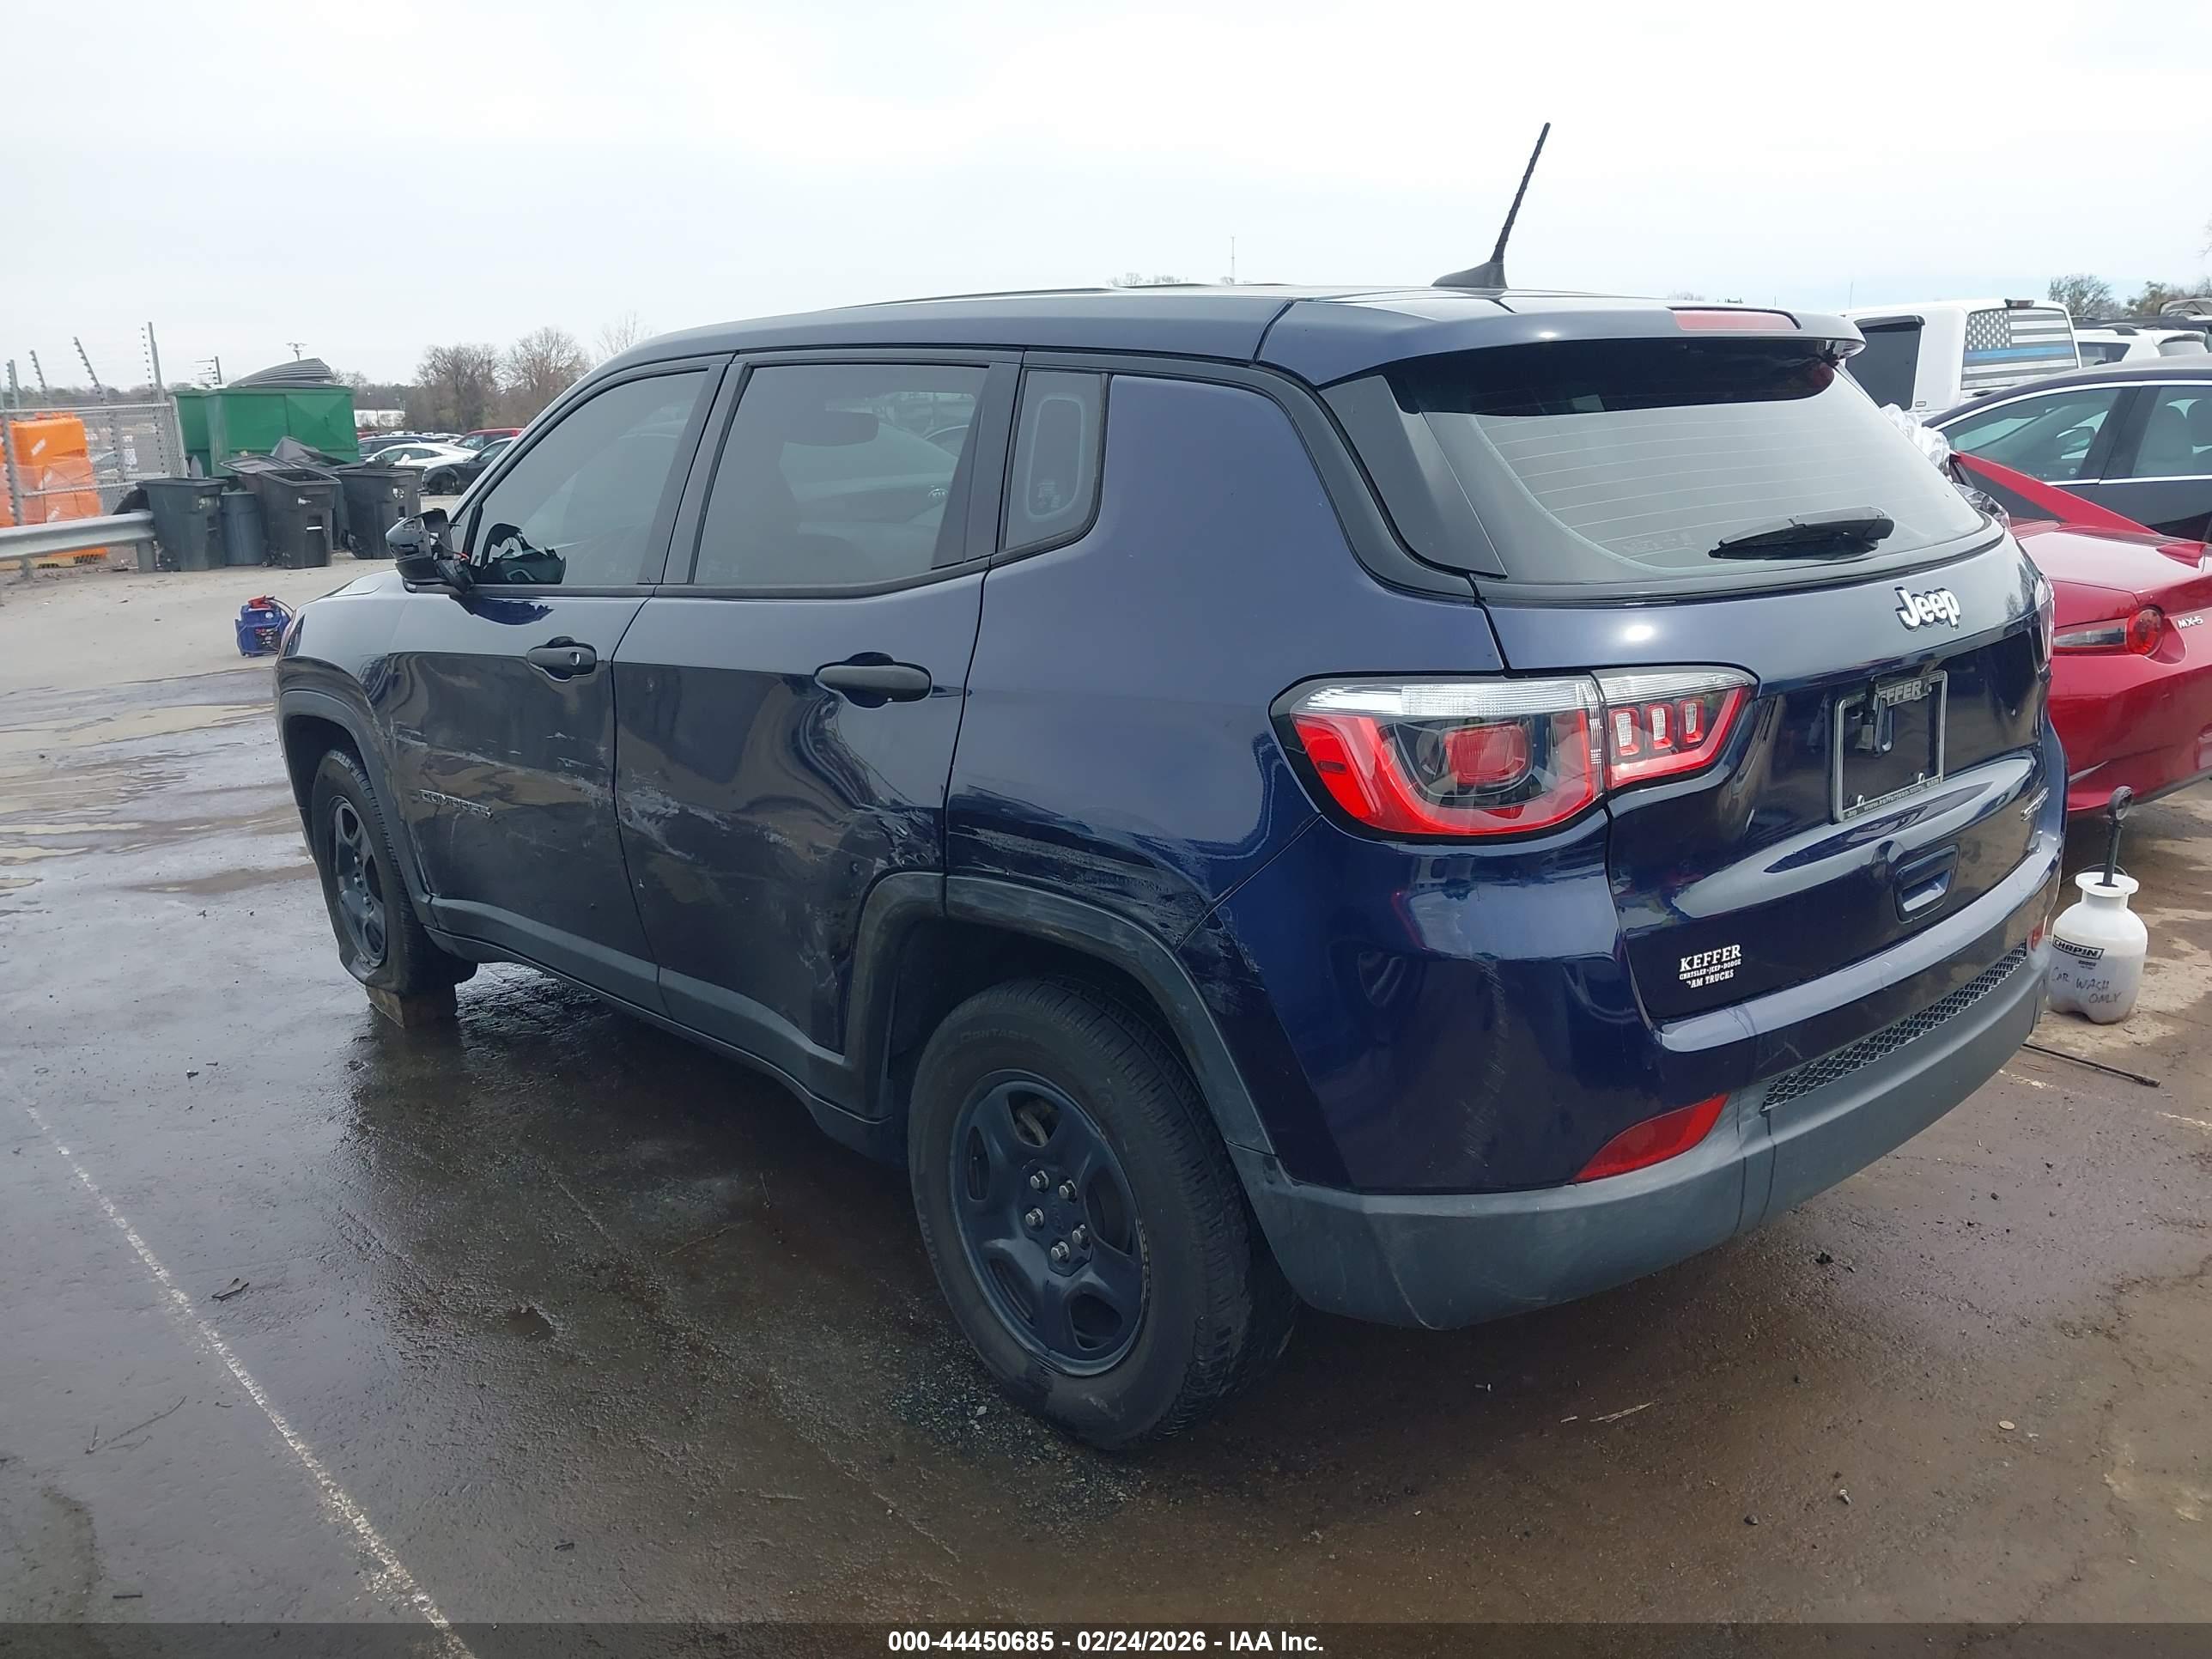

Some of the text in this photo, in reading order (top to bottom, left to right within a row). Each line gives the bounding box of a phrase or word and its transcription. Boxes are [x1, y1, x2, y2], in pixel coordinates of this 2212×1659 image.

[1896, 588, 1960, 629] Jeep
[2177, 616, 2203, 629] MX-5
[2054, 939, 2099, 957] CHAPIN
[1680, 945, 1742, 972] KEFFER
[1705, 969, 1735, 985] TRUCKS
[2075, 977, 2110, 991] WASH
[2088, 992, 2122, 1004] ONLY
